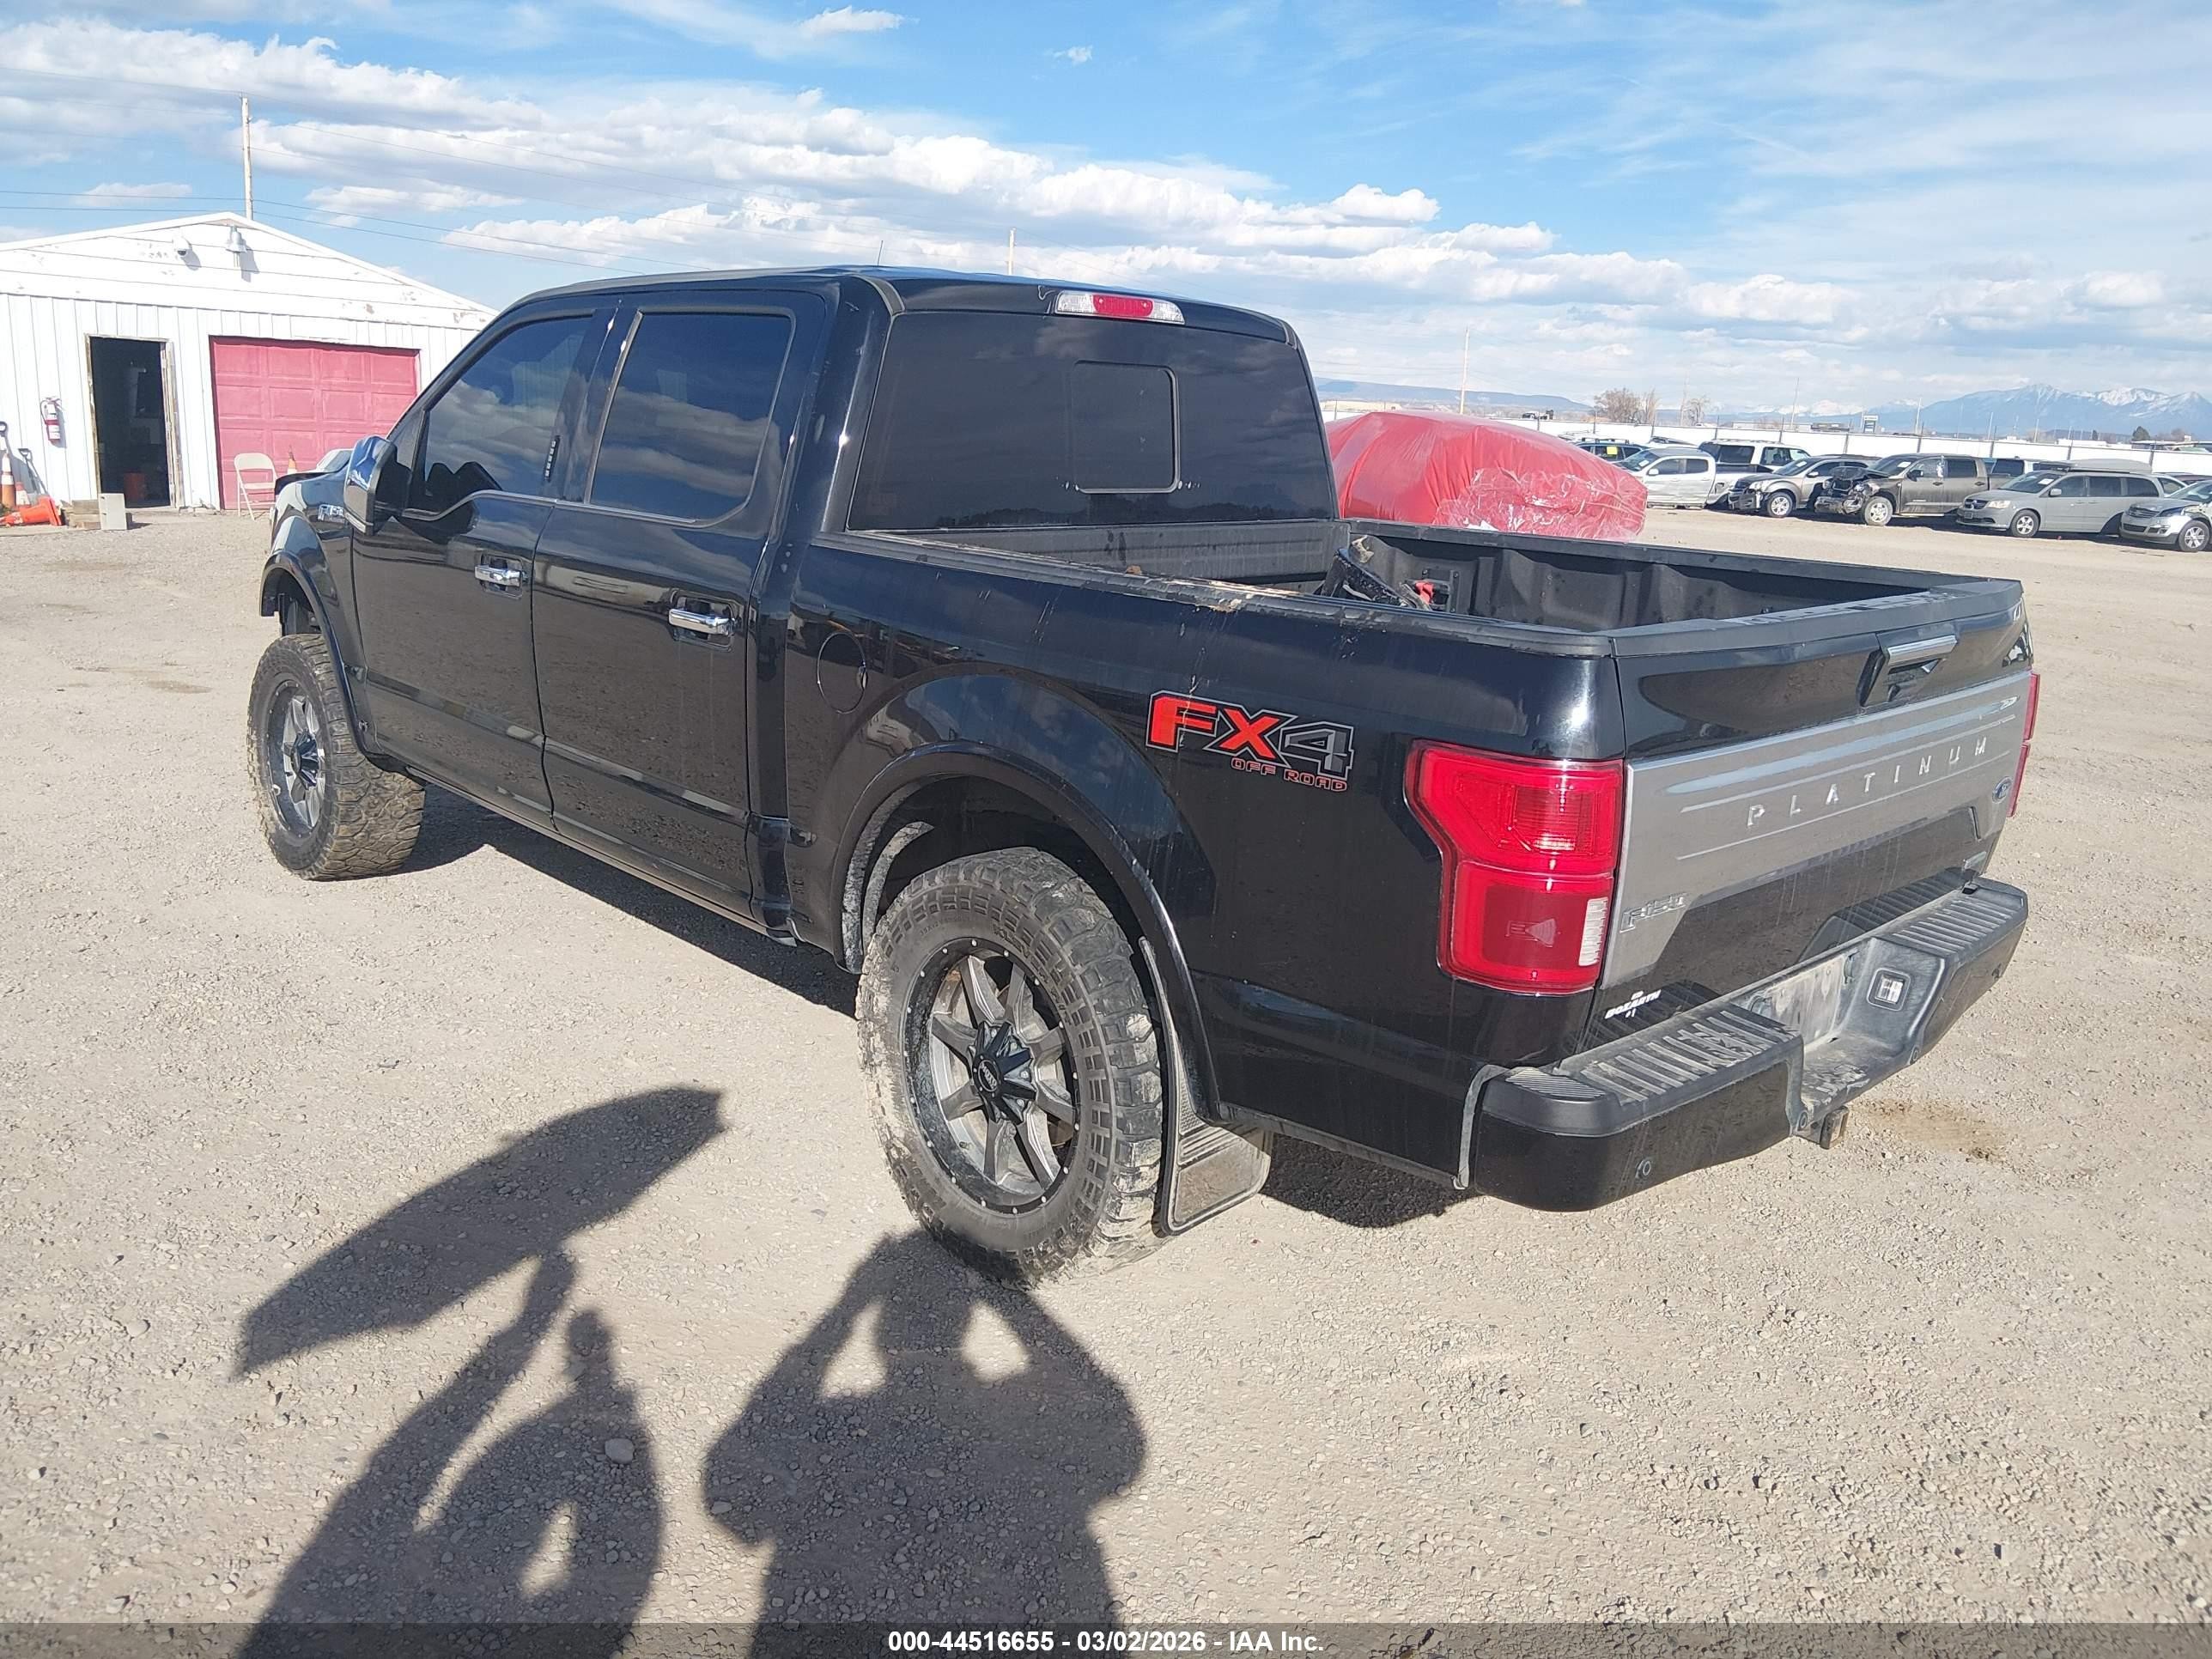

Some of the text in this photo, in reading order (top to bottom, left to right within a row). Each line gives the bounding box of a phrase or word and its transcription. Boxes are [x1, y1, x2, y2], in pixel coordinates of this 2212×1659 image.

[1146, 690, 1354, 781] FX4
[1231, 757, 1347, 793] OFF ROAD
[1747, 736, 1987, 827] PLATINUM
